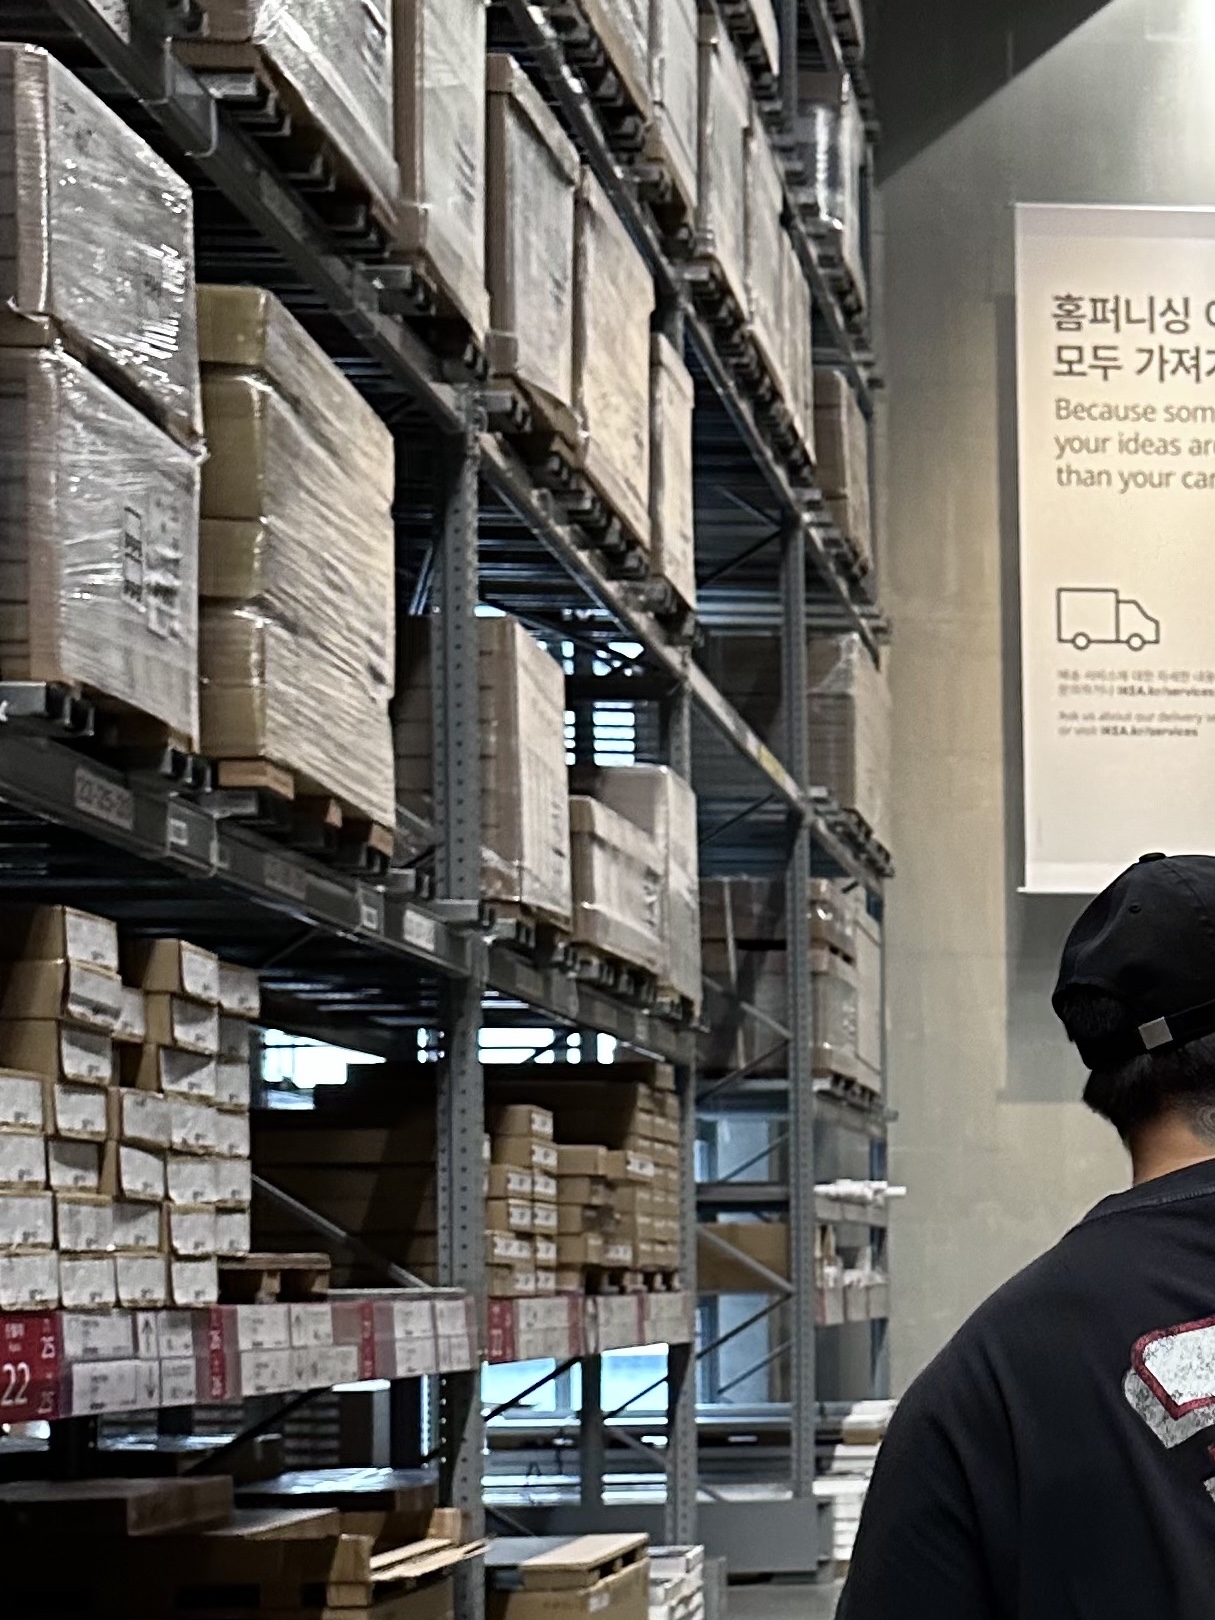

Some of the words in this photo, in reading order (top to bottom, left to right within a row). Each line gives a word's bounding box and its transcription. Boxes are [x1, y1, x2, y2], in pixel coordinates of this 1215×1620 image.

[1051, 293, 1191, 334] 홈퍼니싱
[1052, 344, 1123, 382] 모두
[1054, 397, 1157, 422] Because
[1053, 434, 1112, 460] your
[1118, 431, 1182, 456] ideas
[1056, 464, 1112, 488] than
[1119, 468, 1176, 494] your
[0, 1361, 31, 1406] 22
